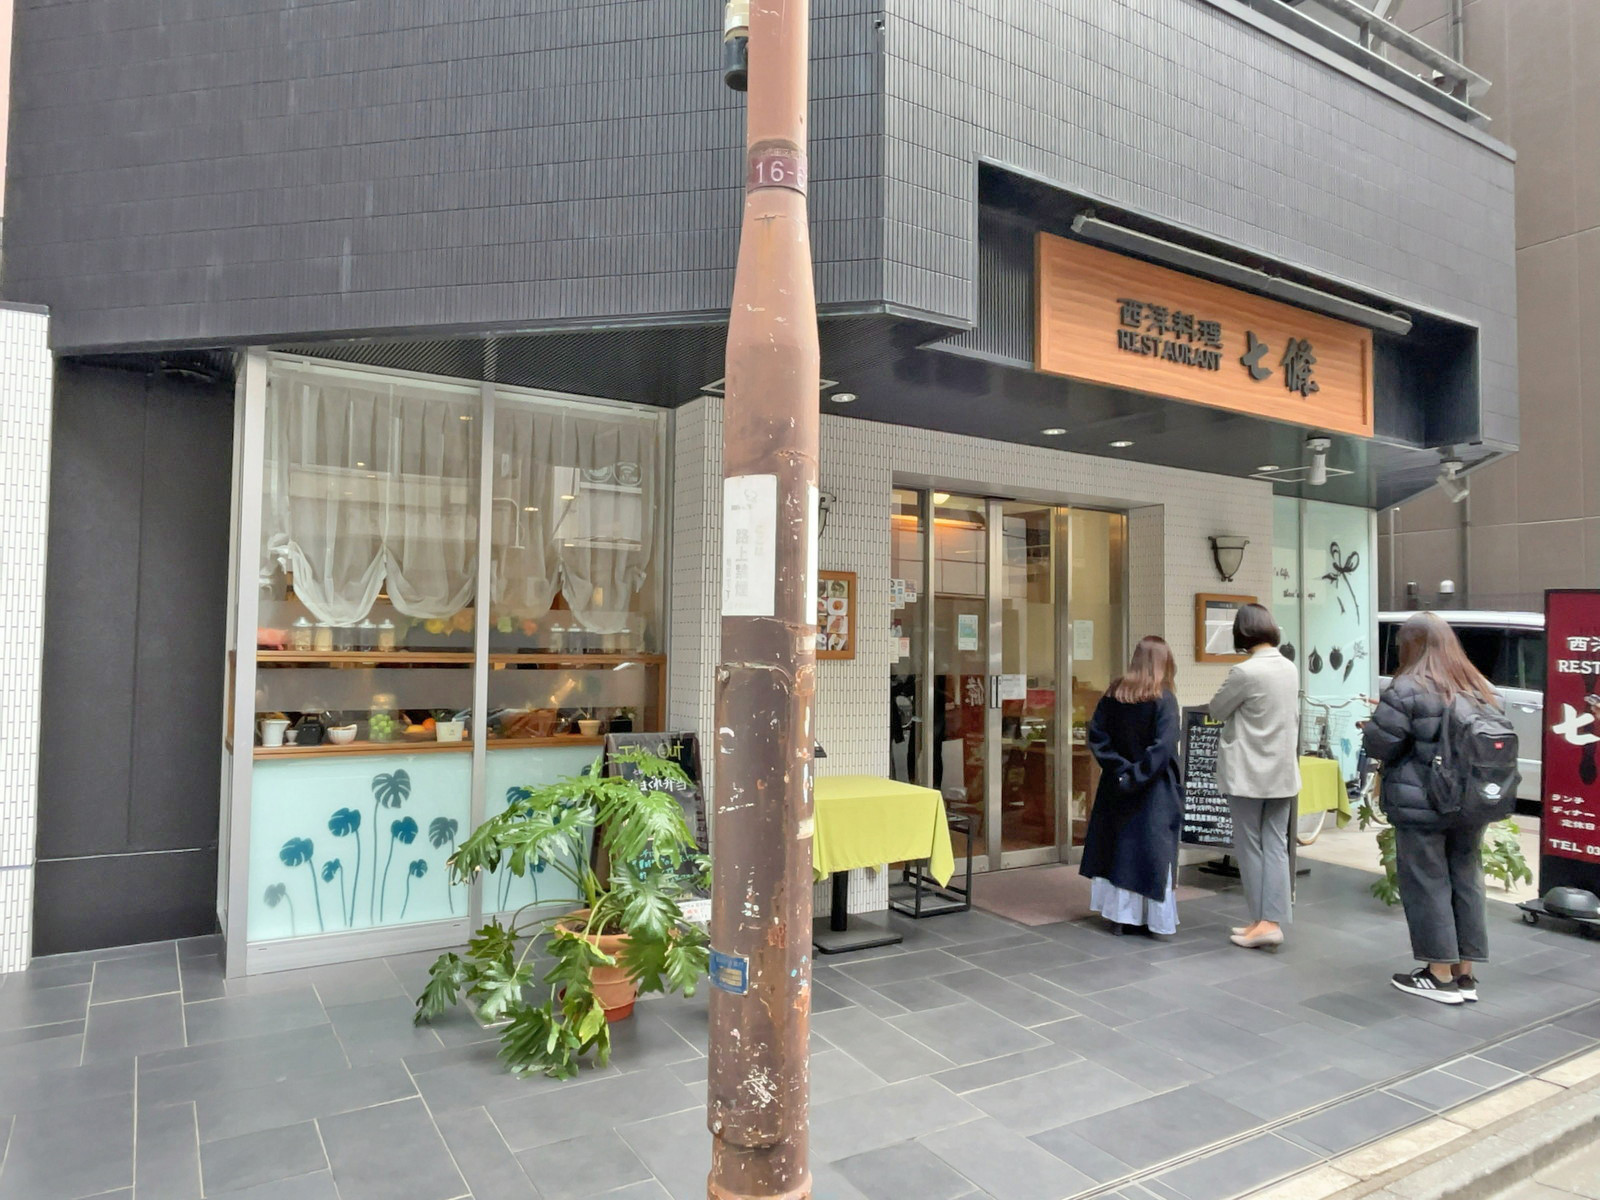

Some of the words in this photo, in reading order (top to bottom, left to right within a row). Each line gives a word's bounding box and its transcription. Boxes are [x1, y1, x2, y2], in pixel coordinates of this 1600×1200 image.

[1117, 298, 1222, 349] 西洋料理
[1117, 329, 1222, 371] RESTAURANT
[1558, 659, 1600, 675] REST
[657, 740, 684, 760] Out
[628, 776, 687, 792] まぐれ弁当
[1552, 794, 1585, 805] ランチ
[1552, 806, 1596, 818] ディナー
[1561, 819, 1595, 831] 定休日
[1549, 838, 1583, 853] TEL
